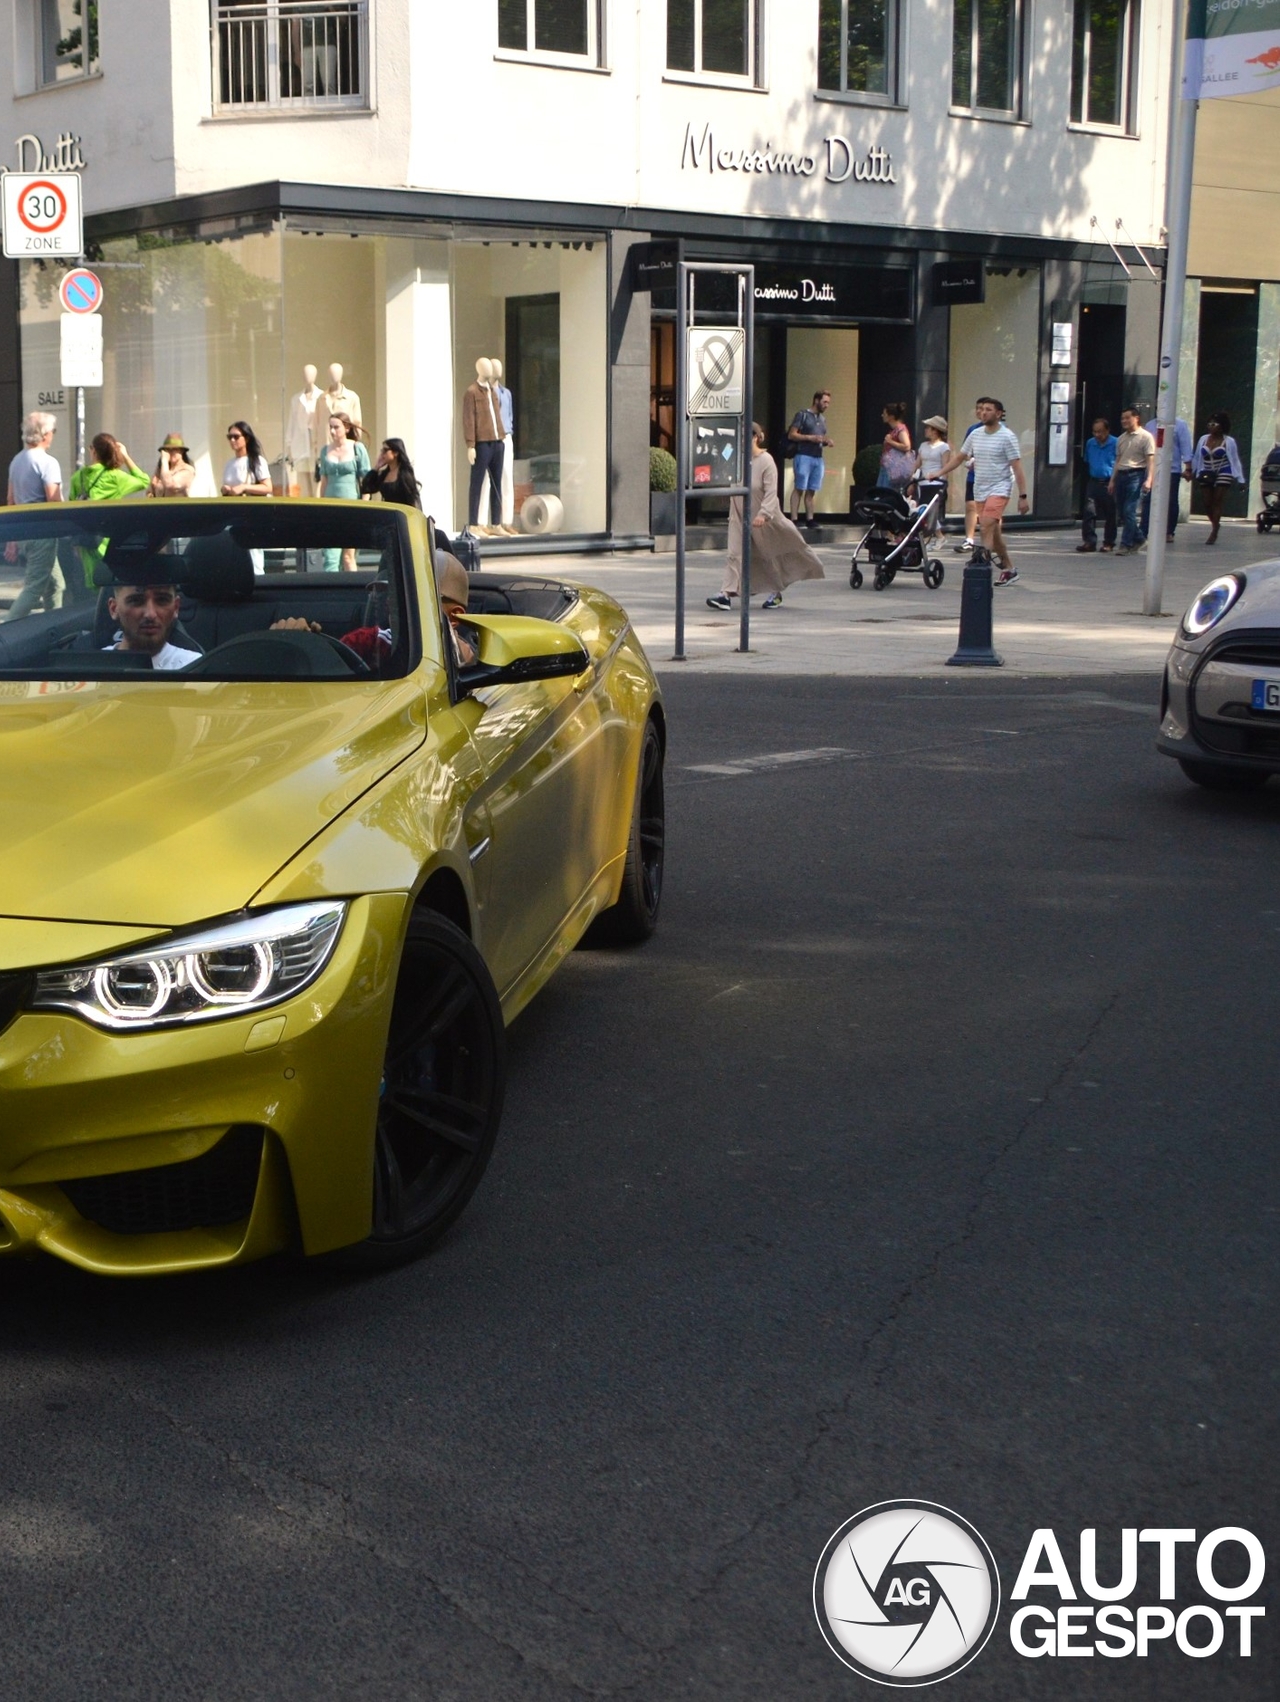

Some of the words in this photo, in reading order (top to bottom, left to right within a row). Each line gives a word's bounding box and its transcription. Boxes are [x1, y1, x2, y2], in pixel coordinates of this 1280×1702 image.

[15, 131, 88, 173] Dutti
[681, 122, 817, 176] Massimo
[823, 134, 898, 184] Dutti
[28, 195, 56, 219] 30
[25, 237, 62, 249] ZONE
[801, 279, 836, 302] Dutti
[38, 391, 64, 406] SALE
[702, 395, 730, 409] ZONE
